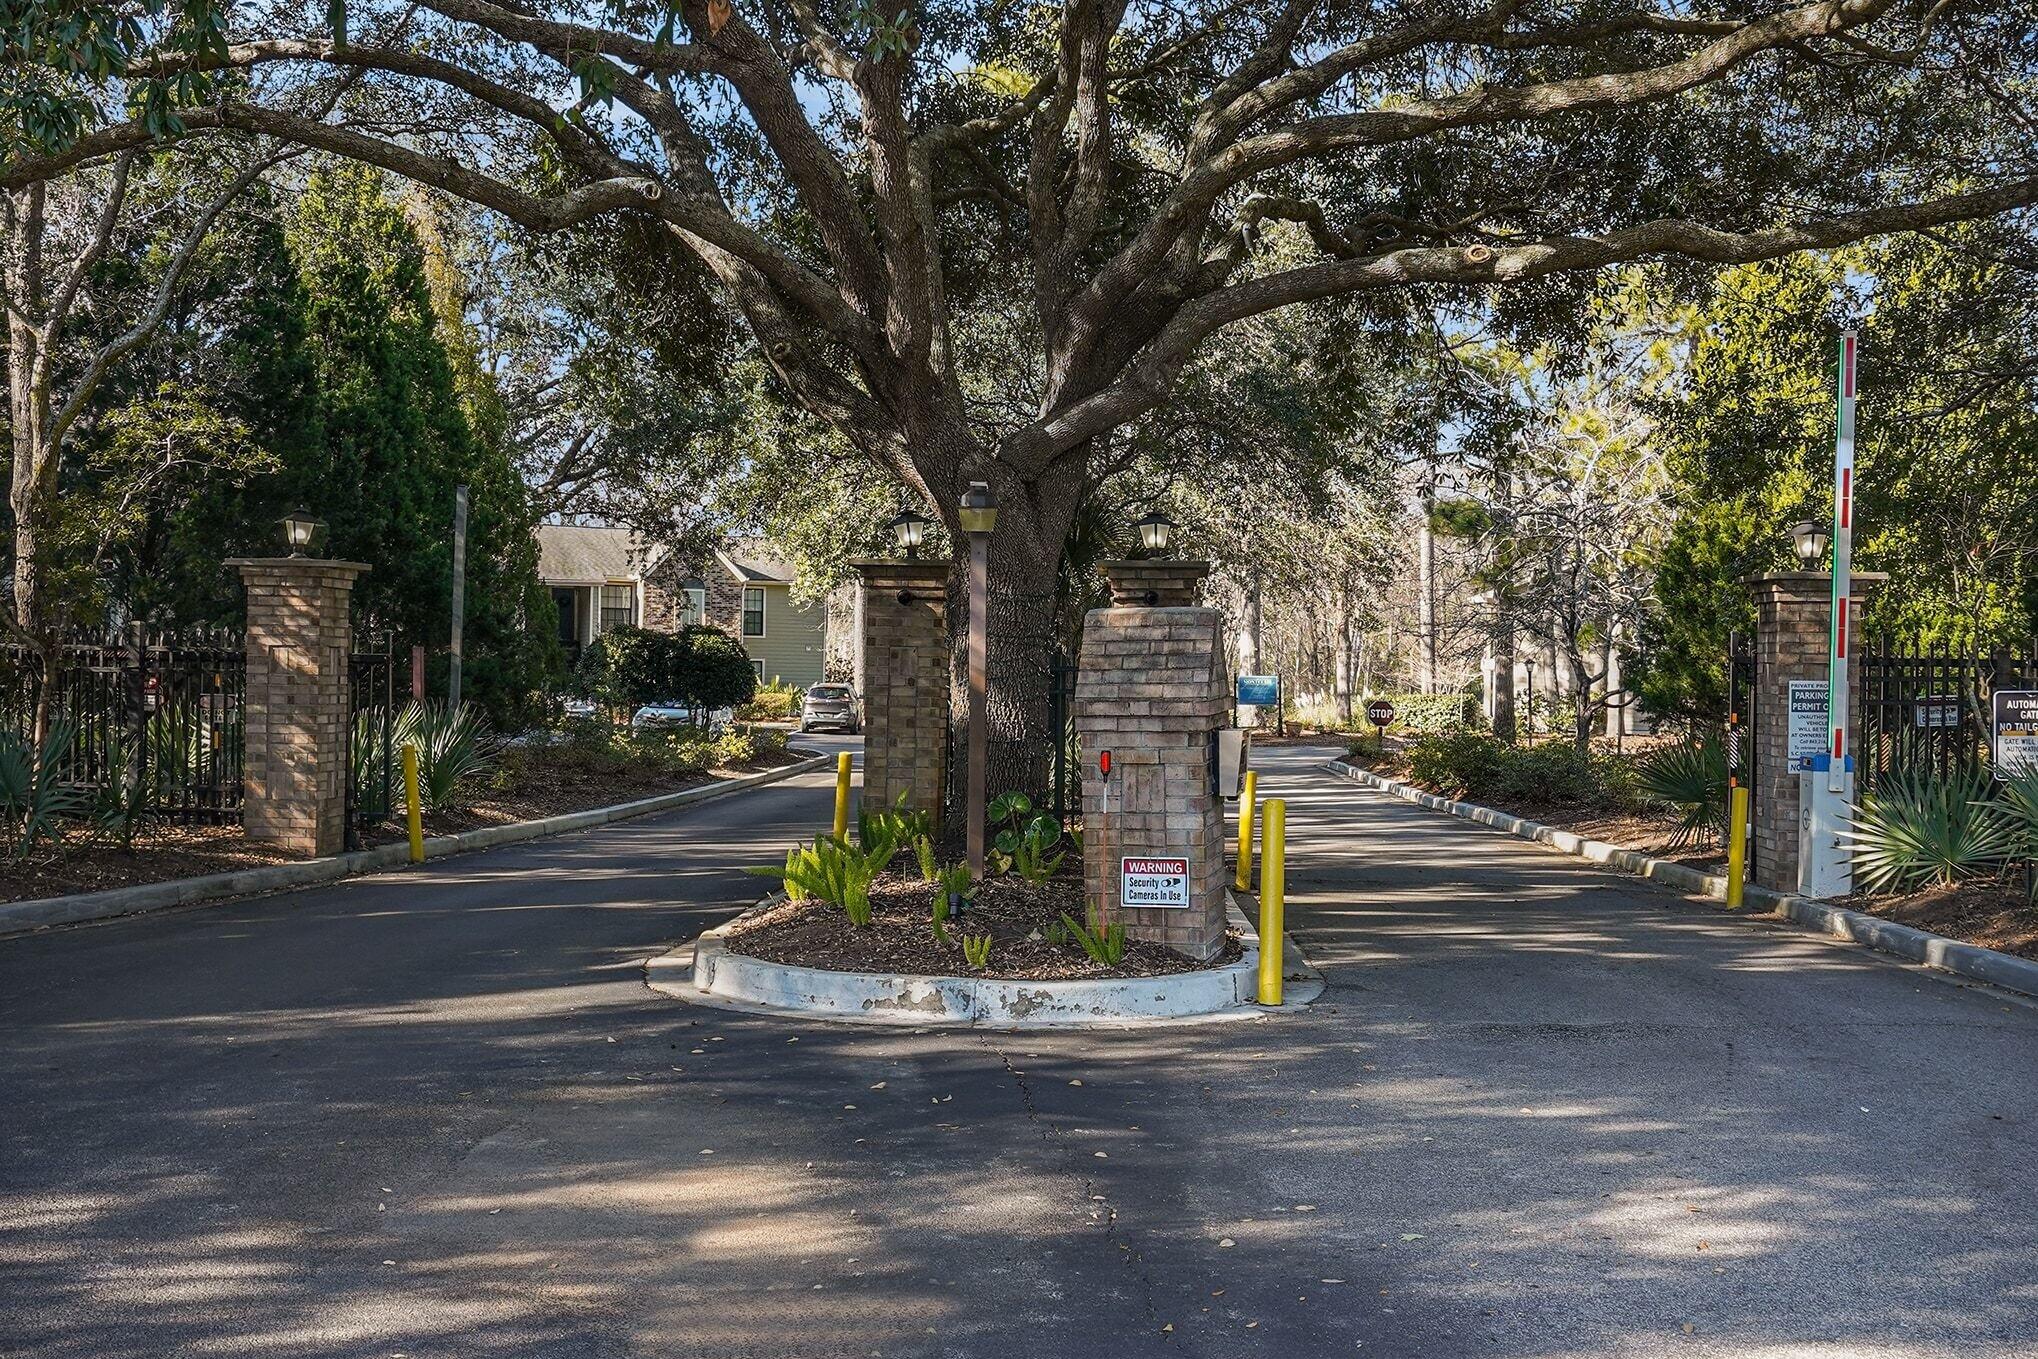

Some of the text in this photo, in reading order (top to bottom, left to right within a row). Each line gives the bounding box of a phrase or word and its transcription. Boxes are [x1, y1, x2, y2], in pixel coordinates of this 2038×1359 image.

[1795, 691, 1829, 700] PARKING
[1792, 702, 1821, 711] PERMIT
[1370, 708, 1393, 719] STOP
[1999, 722, 2012, 731] NO
[1129, 862, 1183, 874] WARNING
[1129, 876, 1160, 889] Security
[1128, 889, 1181, 901] Cameras In Use
